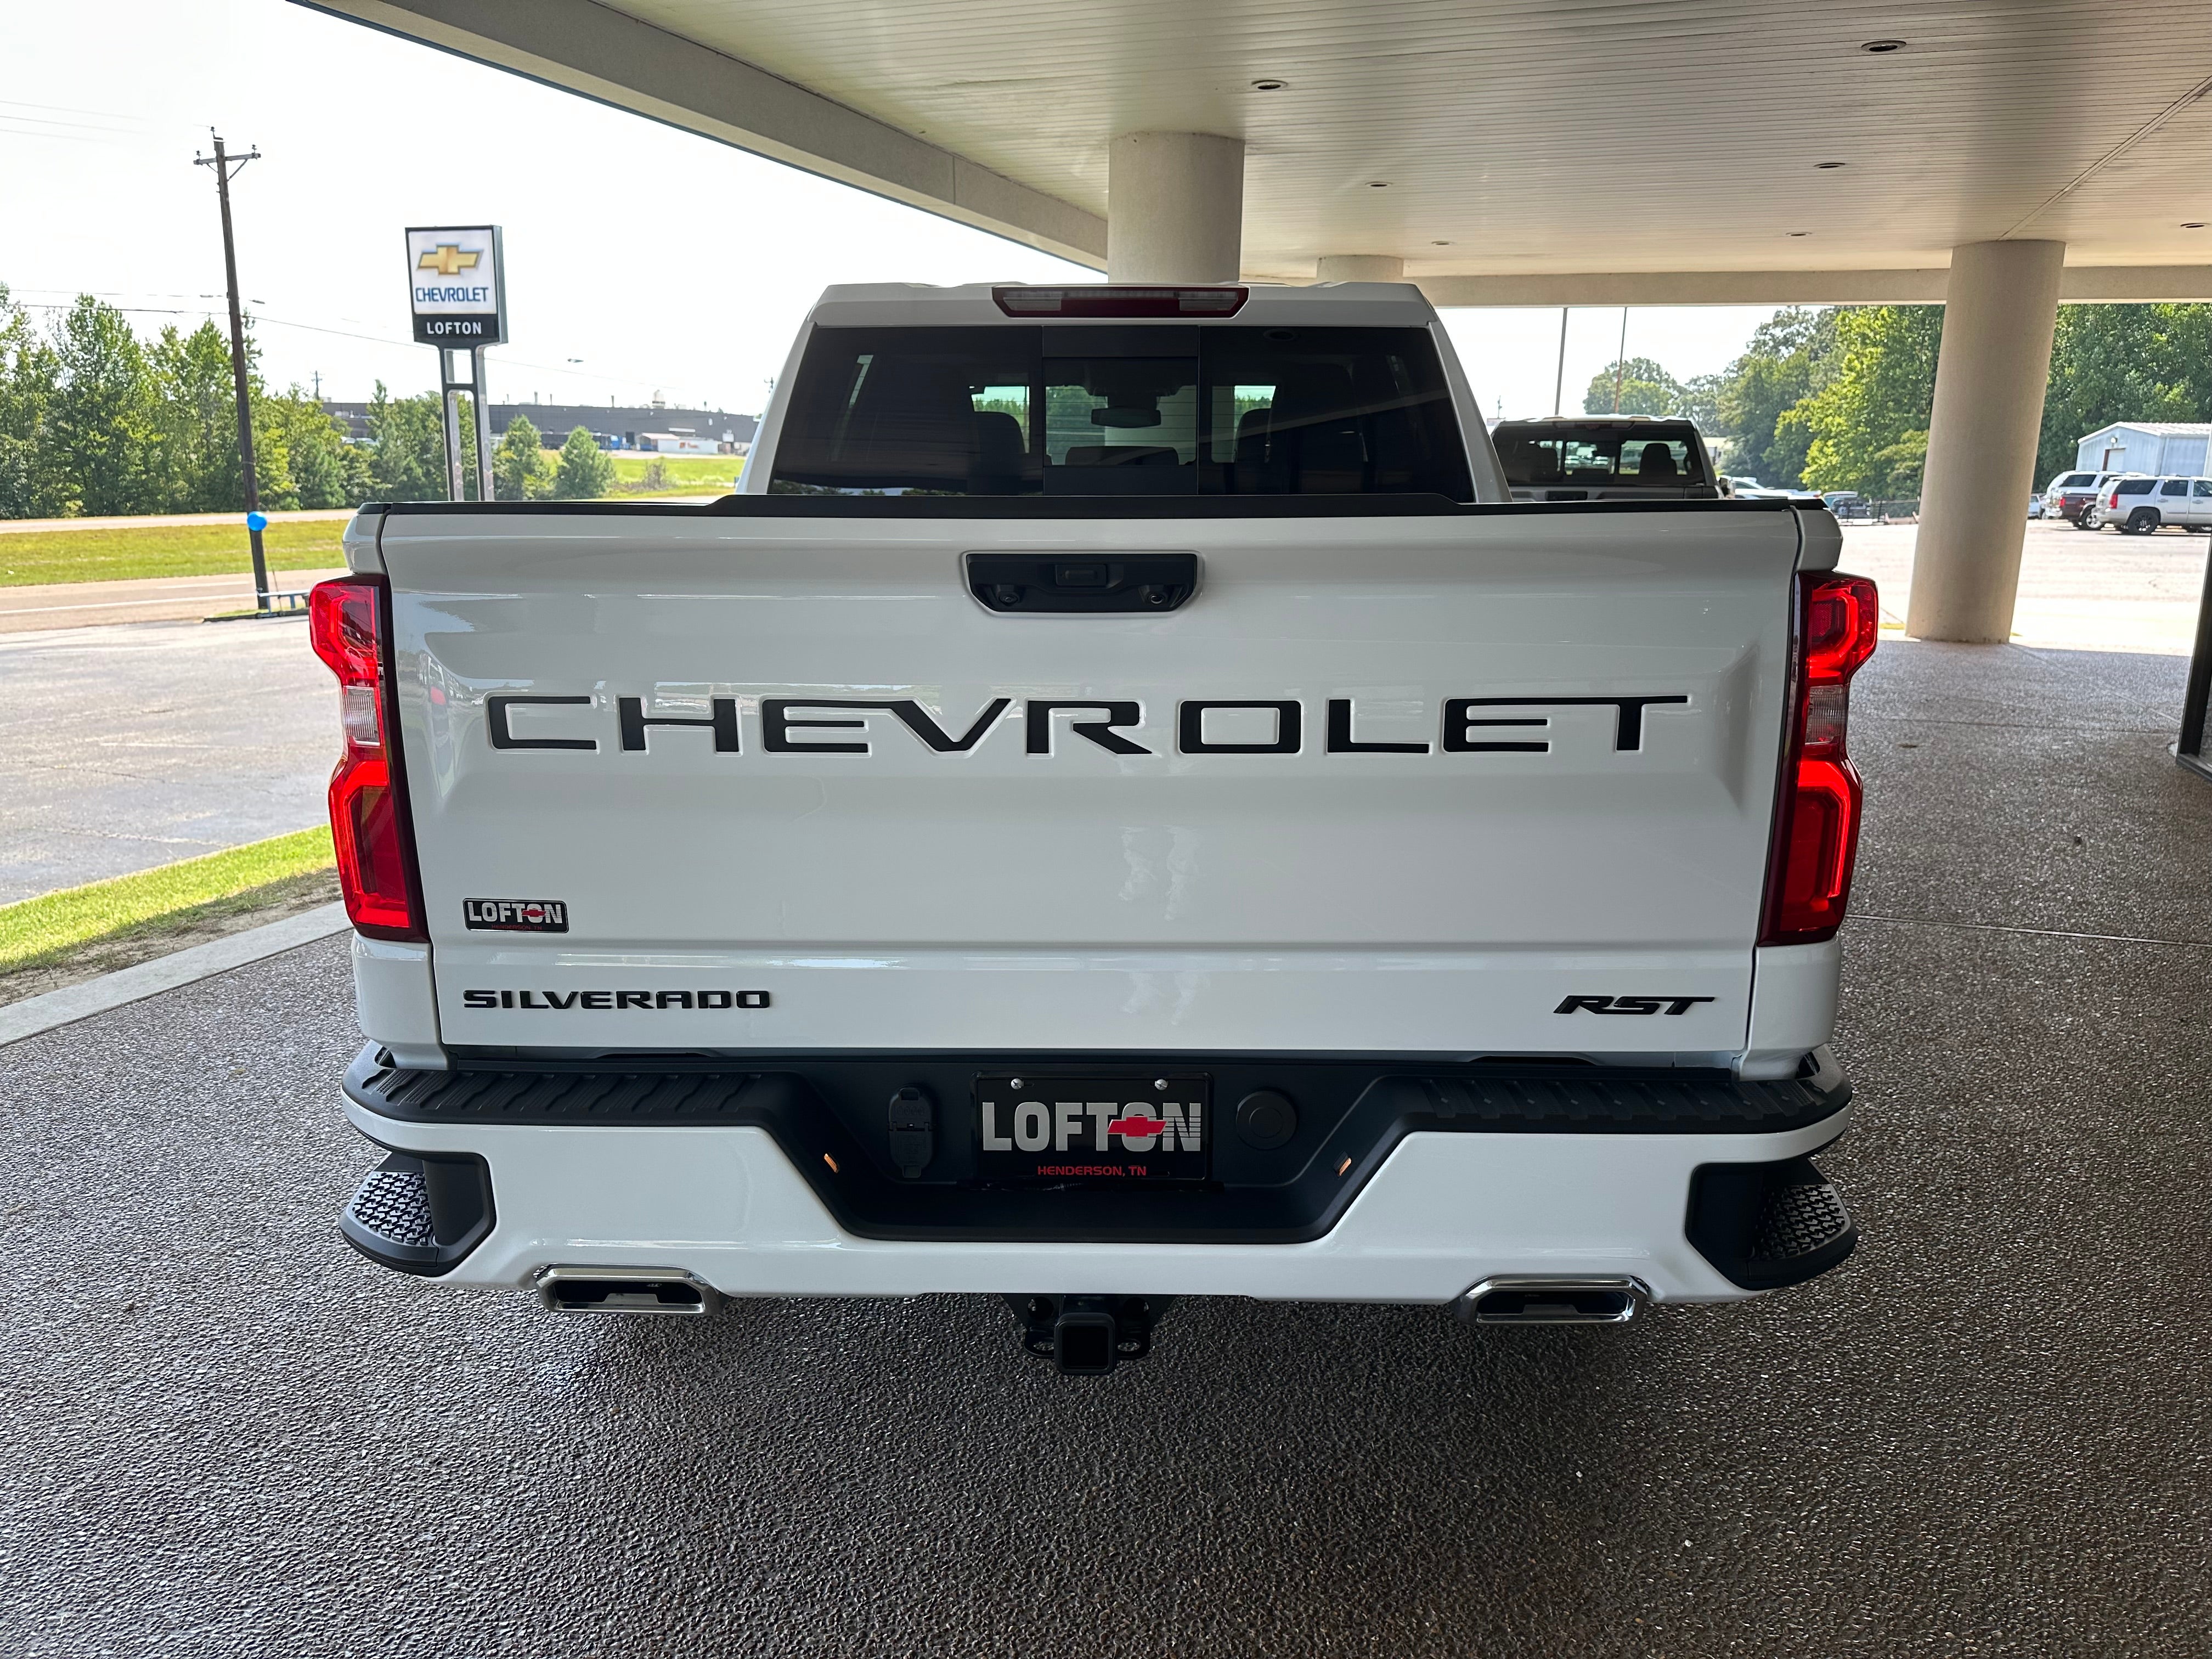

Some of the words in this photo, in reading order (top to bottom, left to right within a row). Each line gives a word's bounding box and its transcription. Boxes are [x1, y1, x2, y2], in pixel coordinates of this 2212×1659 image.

[415, 287, 488, 302] CHEVROLET
[426, 321, 482, 335] LOFTON
[487, 695, 1688, 754] CHEVROLET
[467, 901, 563, 924] LOFTON
[463, 990, 771, 1009] SILVERADO
[1553, 995, 1715, 1015] RST
[982, 1102, 1201, 1152] LOFTON
[1037, 1165, 1126, 1177] HENDERSON,
[1128, 1165, 1147, 1176] TN
